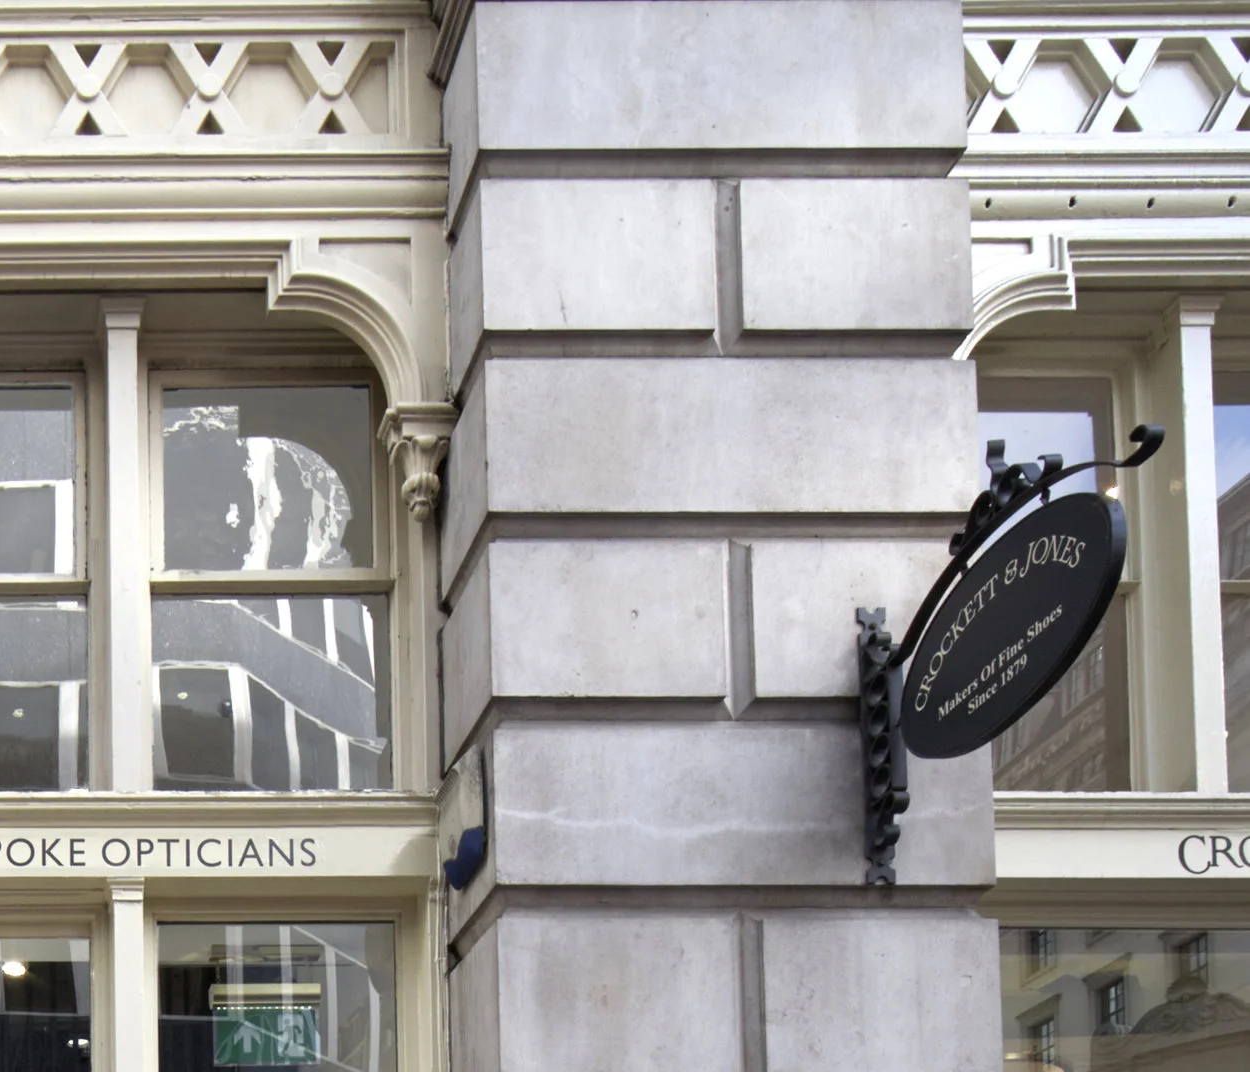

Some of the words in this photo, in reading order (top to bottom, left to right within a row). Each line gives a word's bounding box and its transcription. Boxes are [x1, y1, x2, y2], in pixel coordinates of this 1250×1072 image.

[914, 573, 999, 712] CROCKETT
[1004, 558, 1018, 585] &
[1019, 534, 1086, 579] JONES
[937, 677, 979, 721] Makers
[980, 658, 996, 680] Of
[998, 640, 1024, 668] Fine
[1026, 603, 1063, 642] Shoes
[967, 682, 998, 715] Since
[1000, 653, 1028, 688] 1879
[101, 837, 316, 868] OPTICIANS
